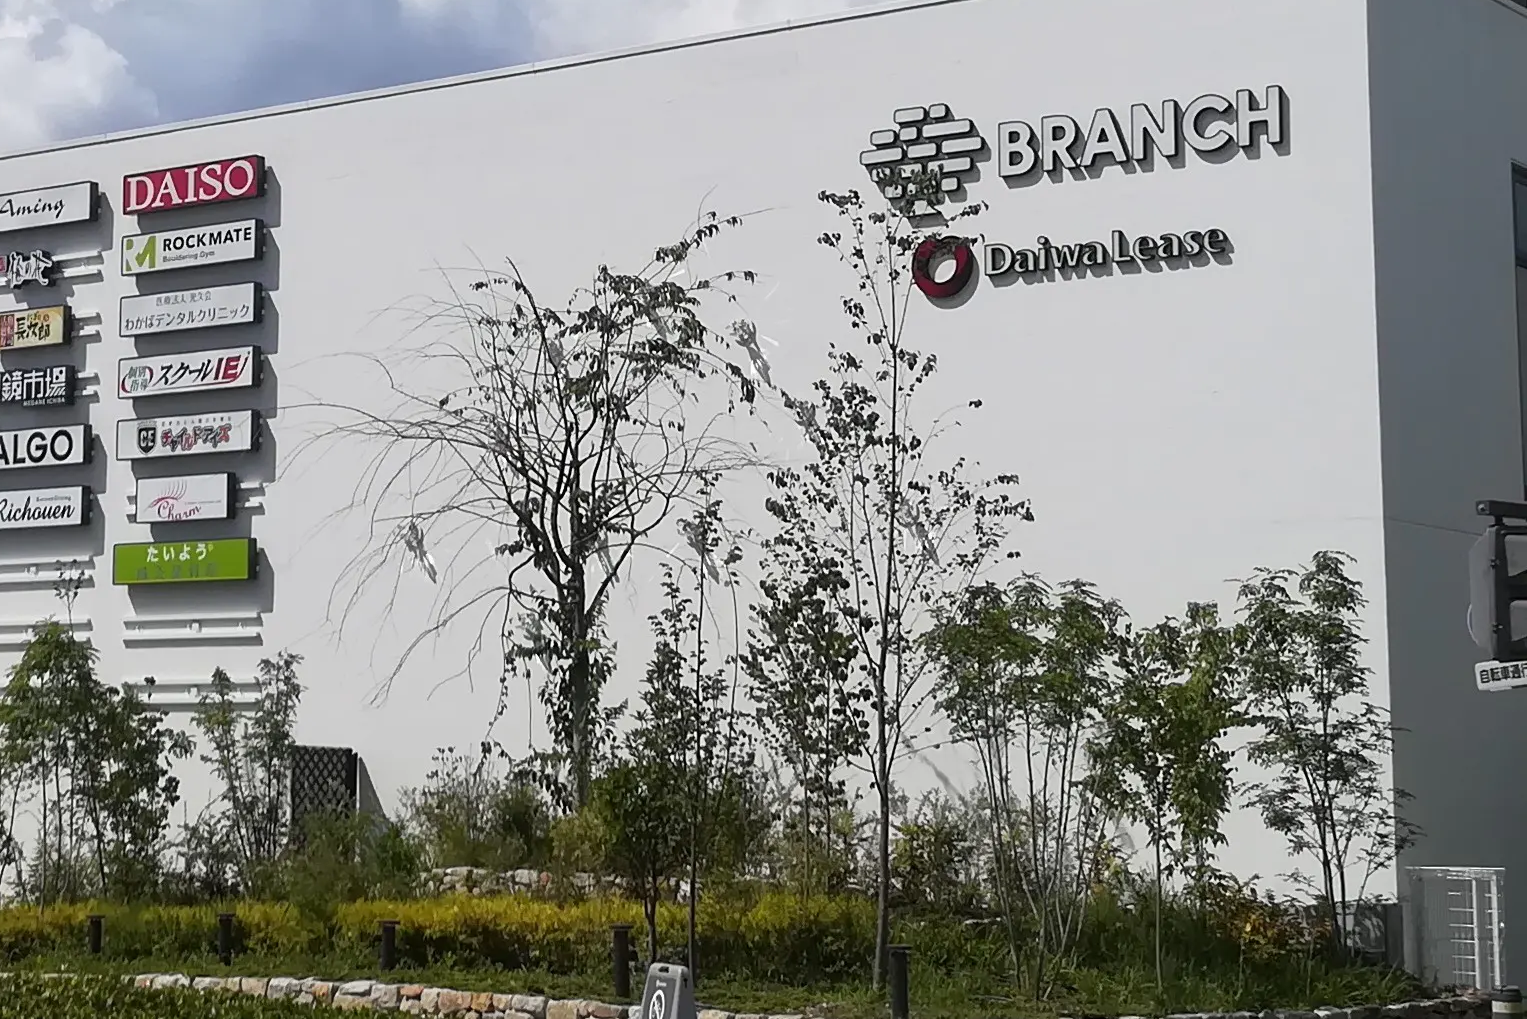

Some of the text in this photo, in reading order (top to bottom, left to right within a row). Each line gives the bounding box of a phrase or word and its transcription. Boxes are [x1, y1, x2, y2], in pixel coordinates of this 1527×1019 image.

[998, 85, 1282, 177] BRANCH
[126, 160, 254, 211] DAISO
[163, 227, 252, 252] ROCKMATE
[984, 228, 1228, 276] Daiwa Lease
[15, 317, 51, 341] 長次郎
[125, 304, 250, 331] わかばデンタルクリニック
[157, 500, 202, 520] Charm
[147, 543, 207, 562] たいよう
